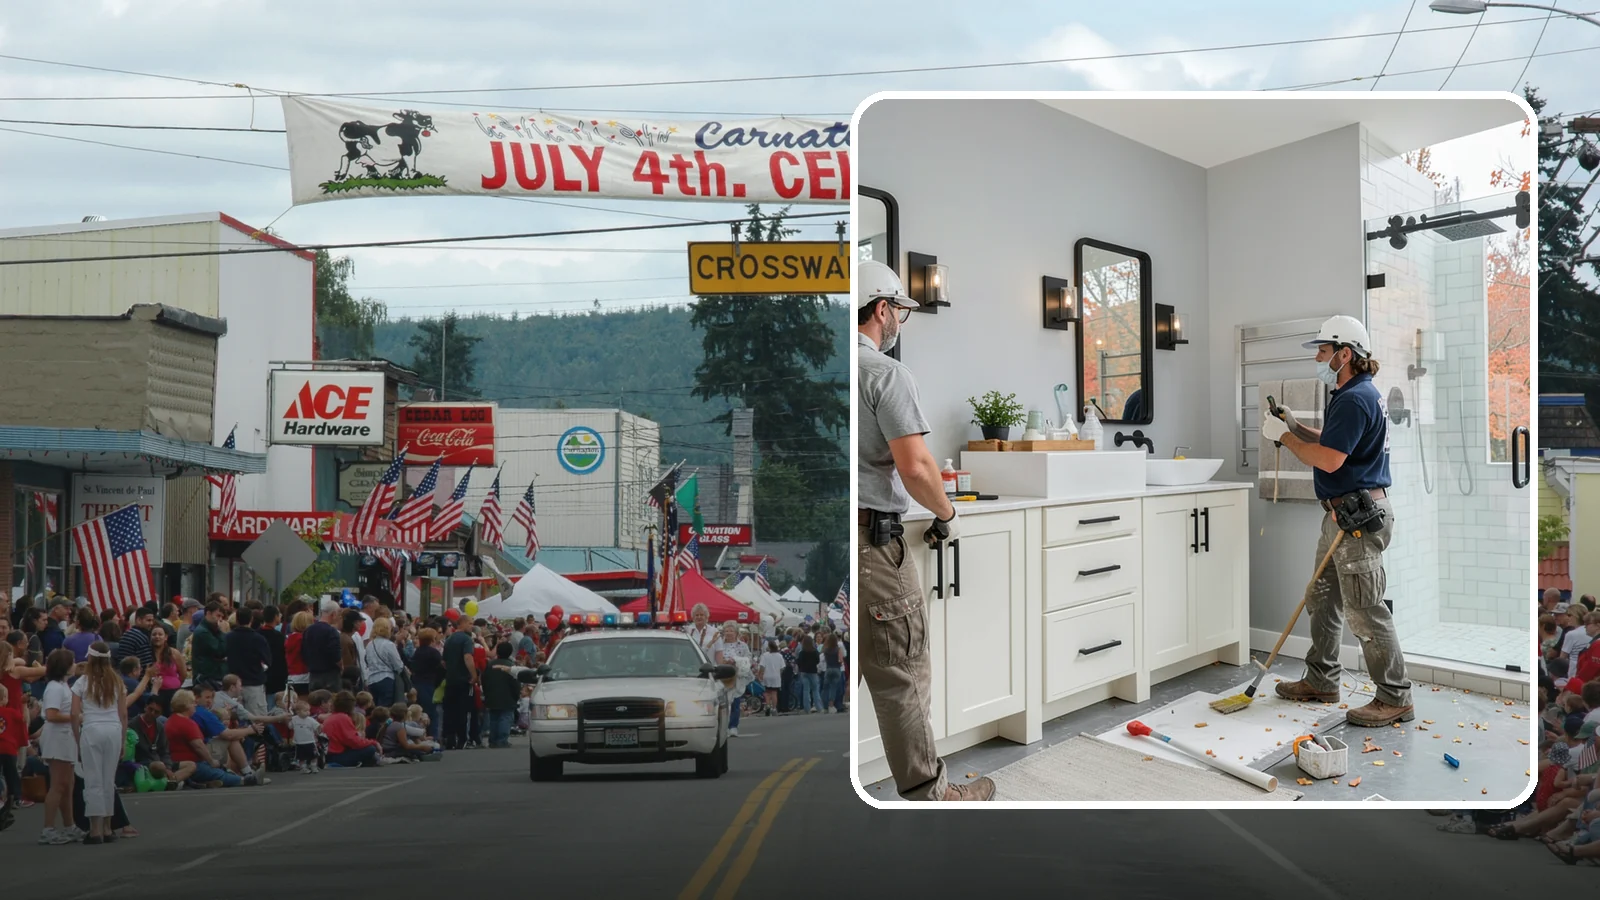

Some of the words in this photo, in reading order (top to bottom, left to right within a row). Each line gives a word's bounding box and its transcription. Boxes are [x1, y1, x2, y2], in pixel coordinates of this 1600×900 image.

[694, 121, 850, 150] Carnat
[481, 141, 605, 192] JULY
[632, 150, 746, 198] 4th.
[697, 254, 850, 280] CROSSWA
[283, 380, 373, 420] ACE
[406, 409, 452, 422] CEDAR
[283, 421, 370, 436] Hardware
[416, 428, 476, 447] Coca-Cola
[96, 485, 123, 494] Vincent
[126, 486, 136, 494] de
[138, 486, 155, 495] Paul
[213, 516, 330, 535] HARDARE
[688, 527, 741, 535] CRNATION
[699, 535, 730, 543] GLASS
